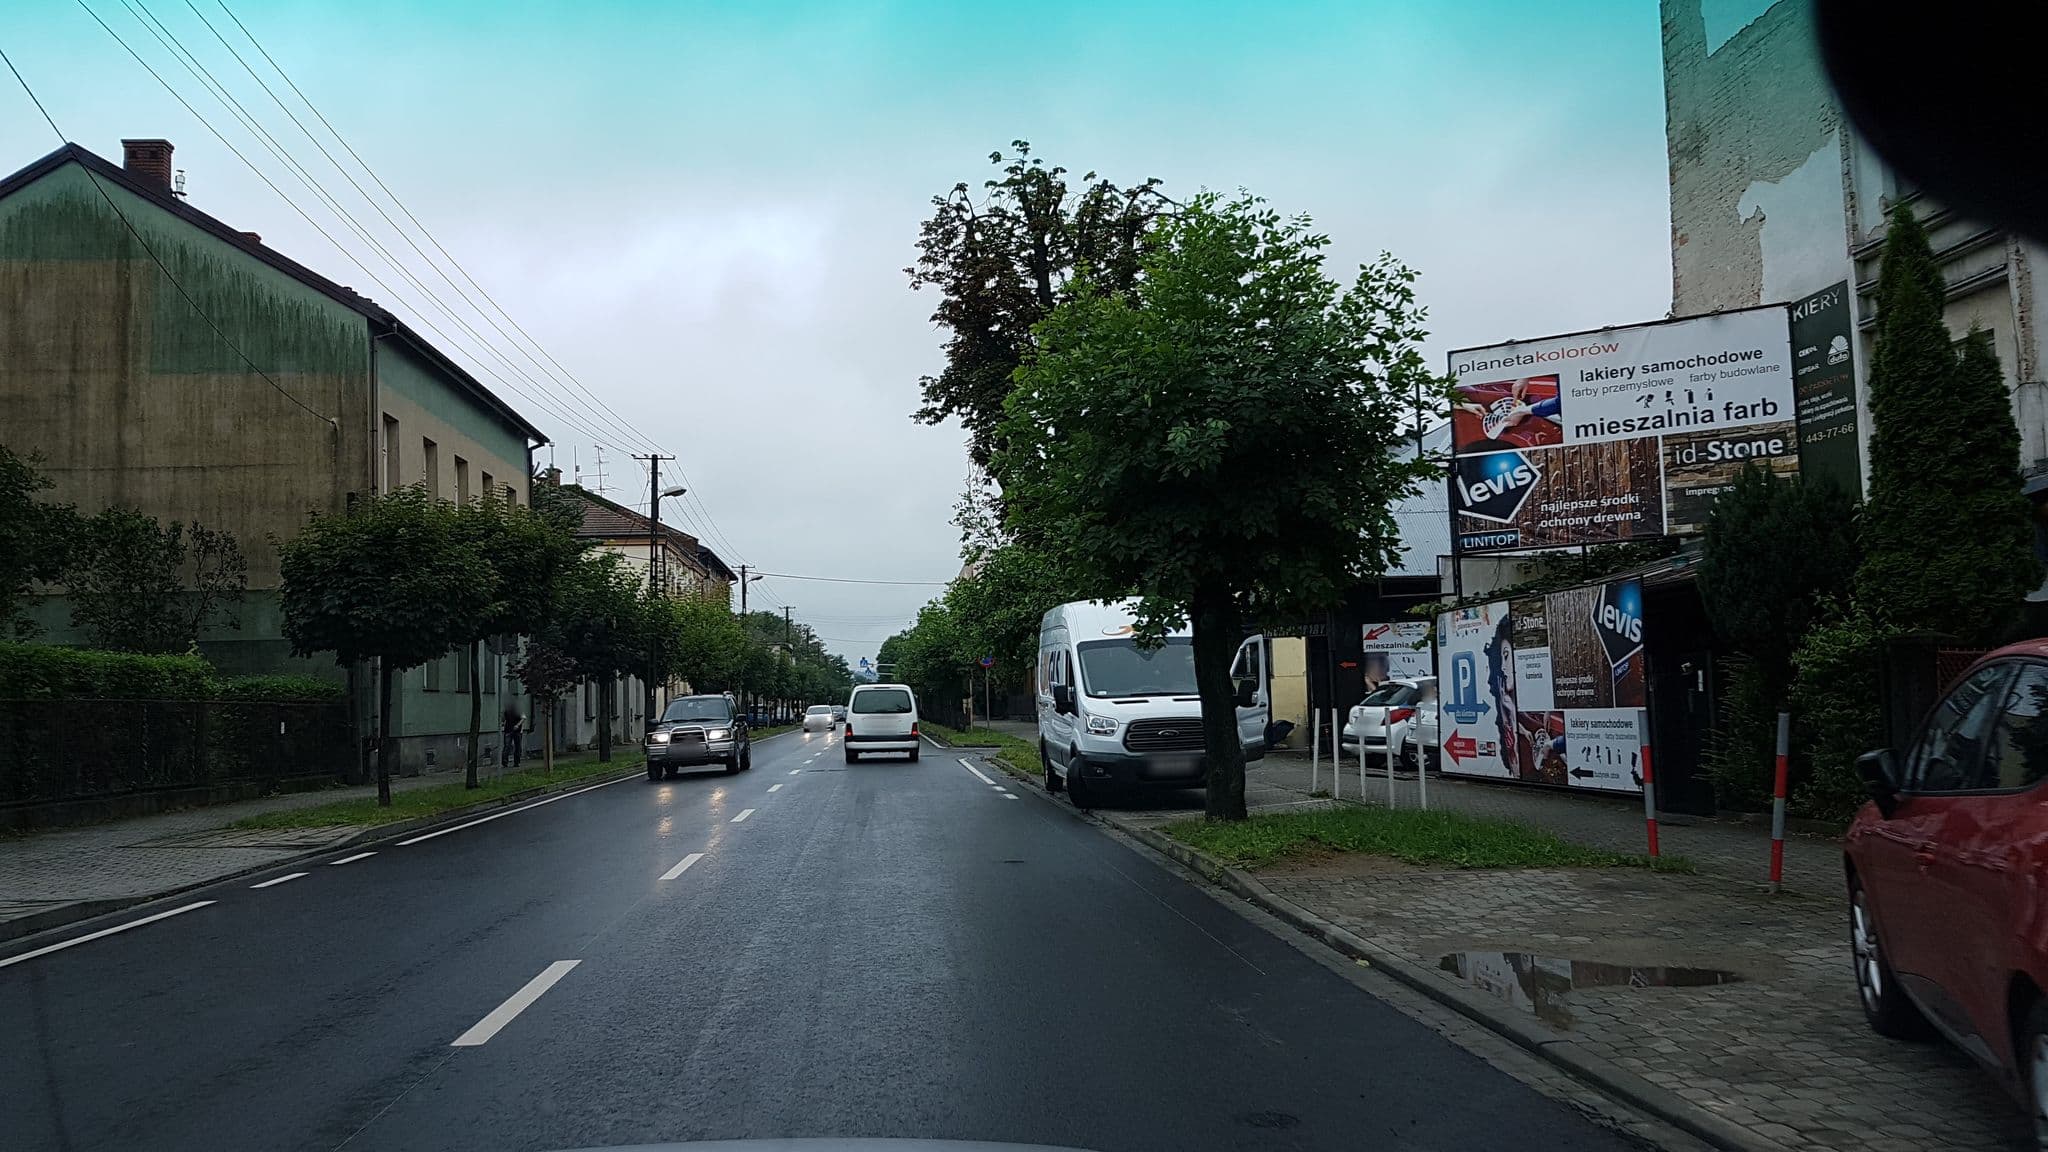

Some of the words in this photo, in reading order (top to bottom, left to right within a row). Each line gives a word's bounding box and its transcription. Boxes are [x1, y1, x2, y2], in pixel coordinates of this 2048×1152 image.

[1458, 342, 1620, 376] planetakolorów
[1580, 365, 1636, 383] lakiery
[1641, 349, 1763, 374] samochodowe
[1571, 387, 1599, 398] farby
[1602, 377, 1674, 395] przemysłowe
[1689, 371, 1717, 384] farby
[1720, 364, 1781, 380] budowlane
[1575, 405, 1715, 439] mieszalnia
[1723, 398, 1779, 421] farb
[1805, 423, 1854, 444] 443-77-66
[1675, 438, 1784, 465] id-Stone
[1457, 464, 1533, 508] levis
[1541, 499, 1598, 513] najlepsze
[1600, 492, 1640, 506] środki
[1539, 514, 1591, 528] ochrony
[1593, 511, 1642, 523] drewna
[1463, 534, 1517, 549] LINITOP
[1598, 584, 1642, 643] levis
[1366, 641, 1410, 650] mieszalnia
[1570, 717, 1590, 731] lakiery
[1591, 718, 1634, 729] samochodowe
